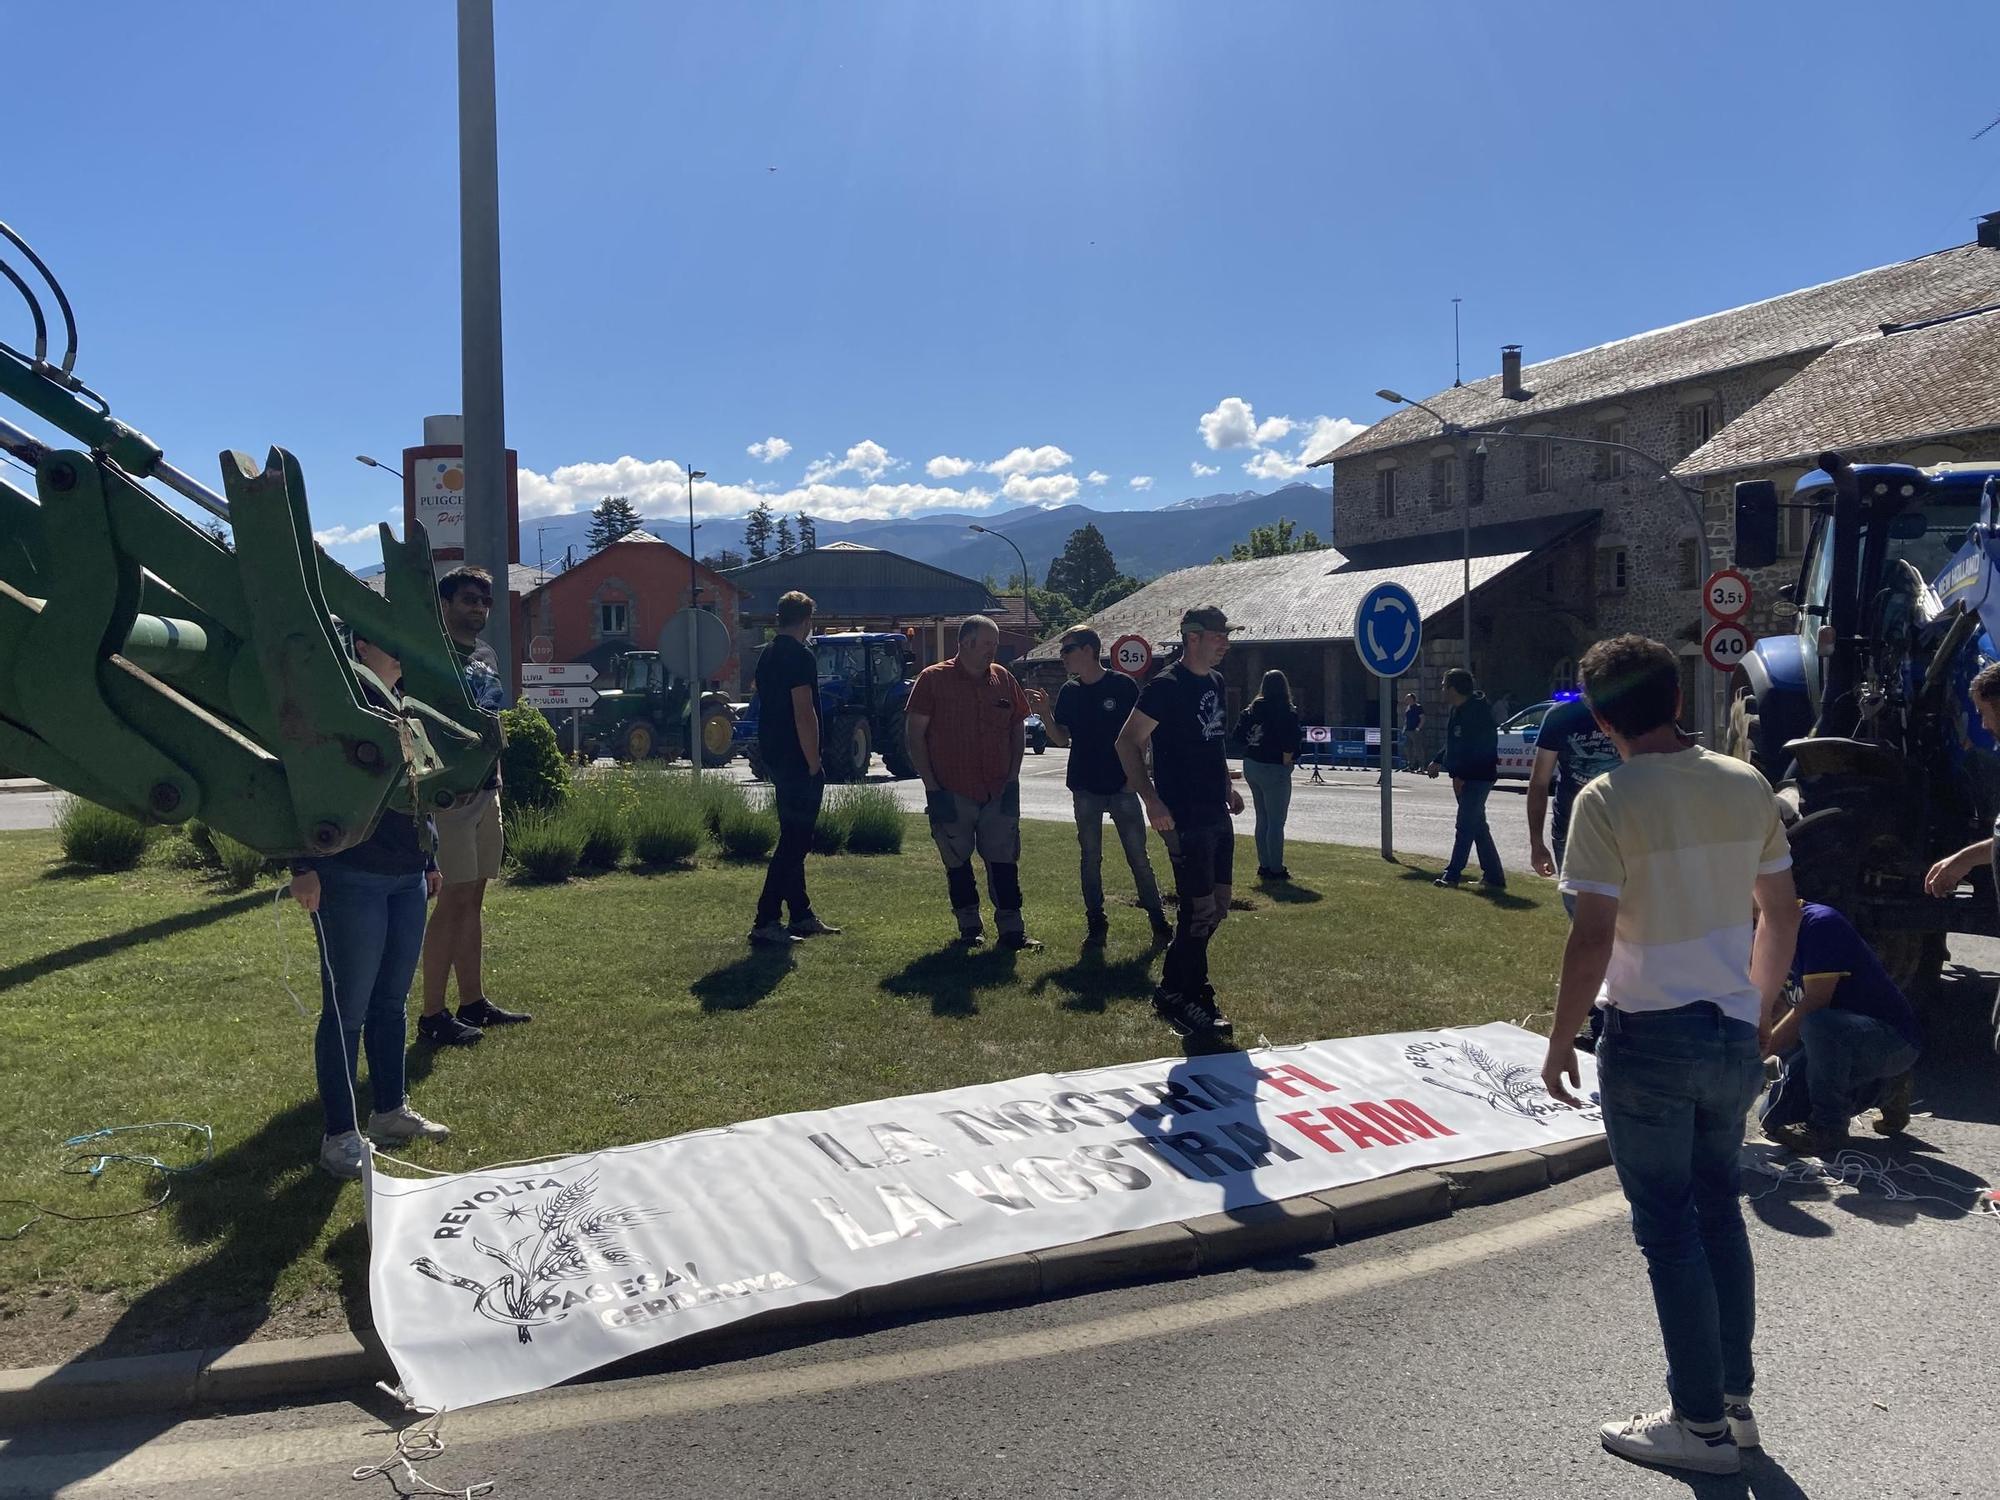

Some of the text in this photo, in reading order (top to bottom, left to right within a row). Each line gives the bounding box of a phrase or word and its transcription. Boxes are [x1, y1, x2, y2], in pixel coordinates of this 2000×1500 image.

[1938, 553, 1980, 597] NEW HOLLAND
[1714, 638, 1744, 655] 40
[1405, 1041, 1456, 1070] REVOLTA
[807, 1063, 1340, 1172] LA NOSTRA FI
[811, 1098, 1461, 1251] LA VOSTRA FAM
[433, 1178, 566, 1240] REVOLTA
[540, 1262, 702, 1316] PAGESA!
[600, 1271, 798, 1328] CERDANYA
